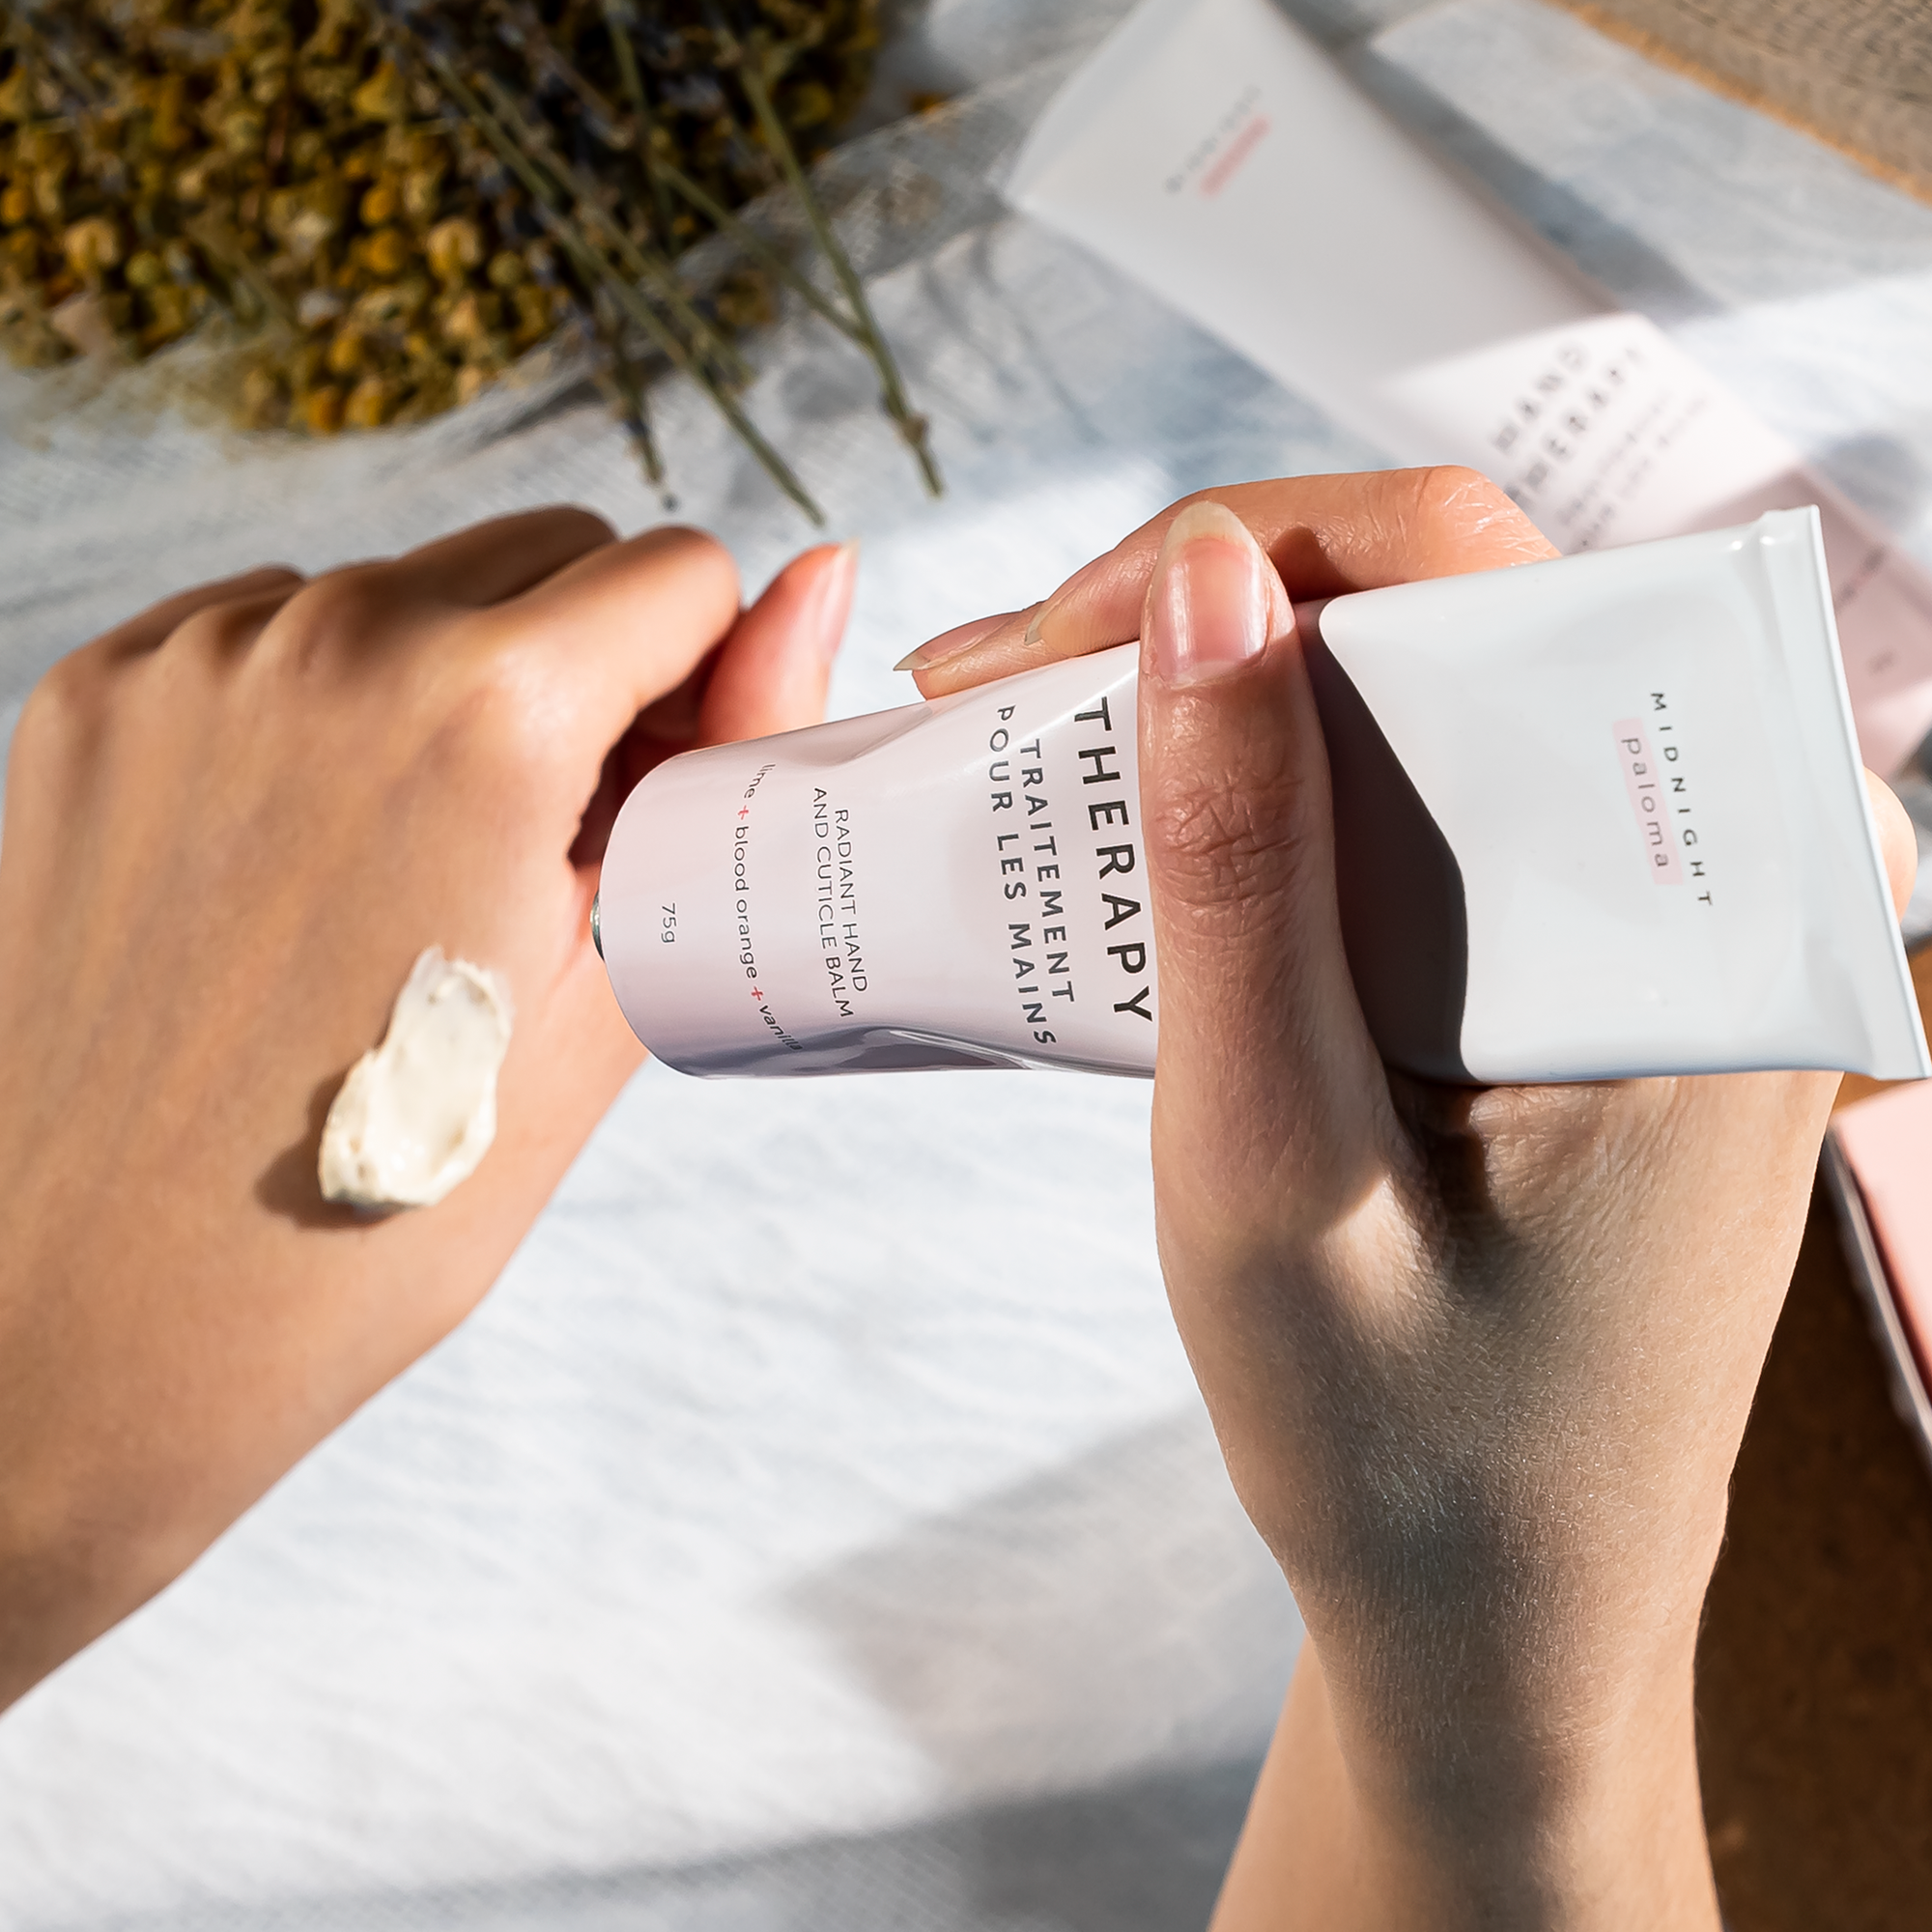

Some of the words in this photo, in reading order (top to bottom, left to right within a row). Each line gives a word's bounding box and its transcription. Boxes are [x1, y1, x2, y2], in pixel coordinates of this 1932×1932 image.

[744, 763, 775, 799] lime
[989, 704, 1015, 811] POUR
[813, 786, 828, 838] AND
[1621, 737, 1669, 867] paloma
[1650, 692, 1713, 906] MIDNIGHT
[734, 825, 750, 891] blood
[816, 845, 838, 949] CUTICLE
[835, 809, 856, 915] RADIANT
[996, 833, 1027, 899] LES
[1020, 738, 1074, 1002] TRAITEMENT
[1074, 696, 1153, 1022] THERAPY
[661, 902, 677, 944] 75g
[735, 898, 757, 979] orange
[842, 923, 867, 992] HAND
[825, 955, 854, 1017] BALM
[1008, 923, 1057, 1044] MAINS
[759, 1005, 803, 1050] vanilla
